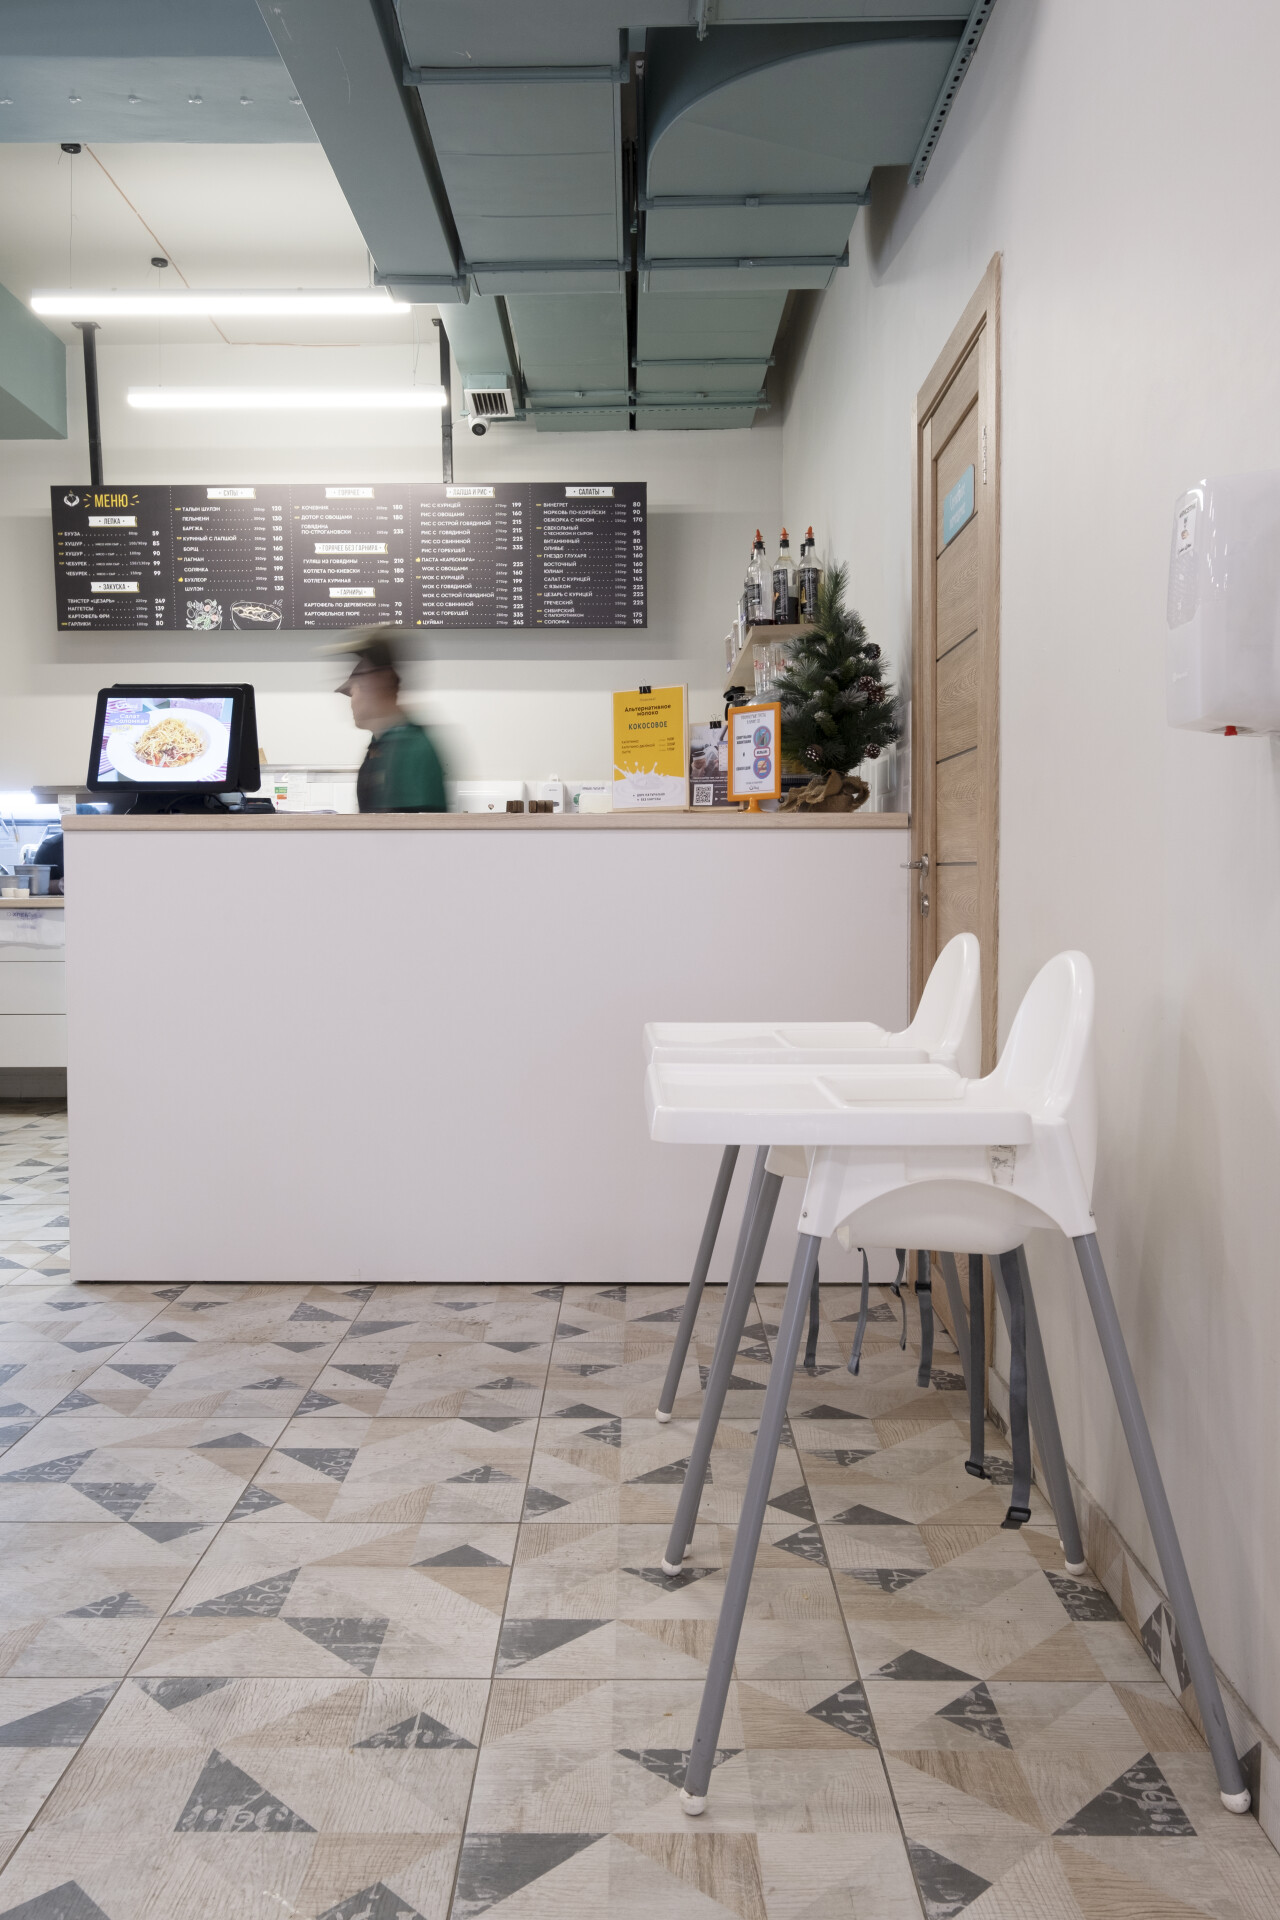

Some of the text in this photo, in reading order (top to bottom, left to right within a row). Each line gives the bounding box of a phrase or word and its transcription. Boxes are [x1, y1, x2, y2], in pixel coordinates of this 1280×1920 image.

[94, 494, 128, 508] МЕНЮ
[624, 704, 671, 713] Альтернативное
[628, 721, 668, 730] КОКОСОВОЕ
